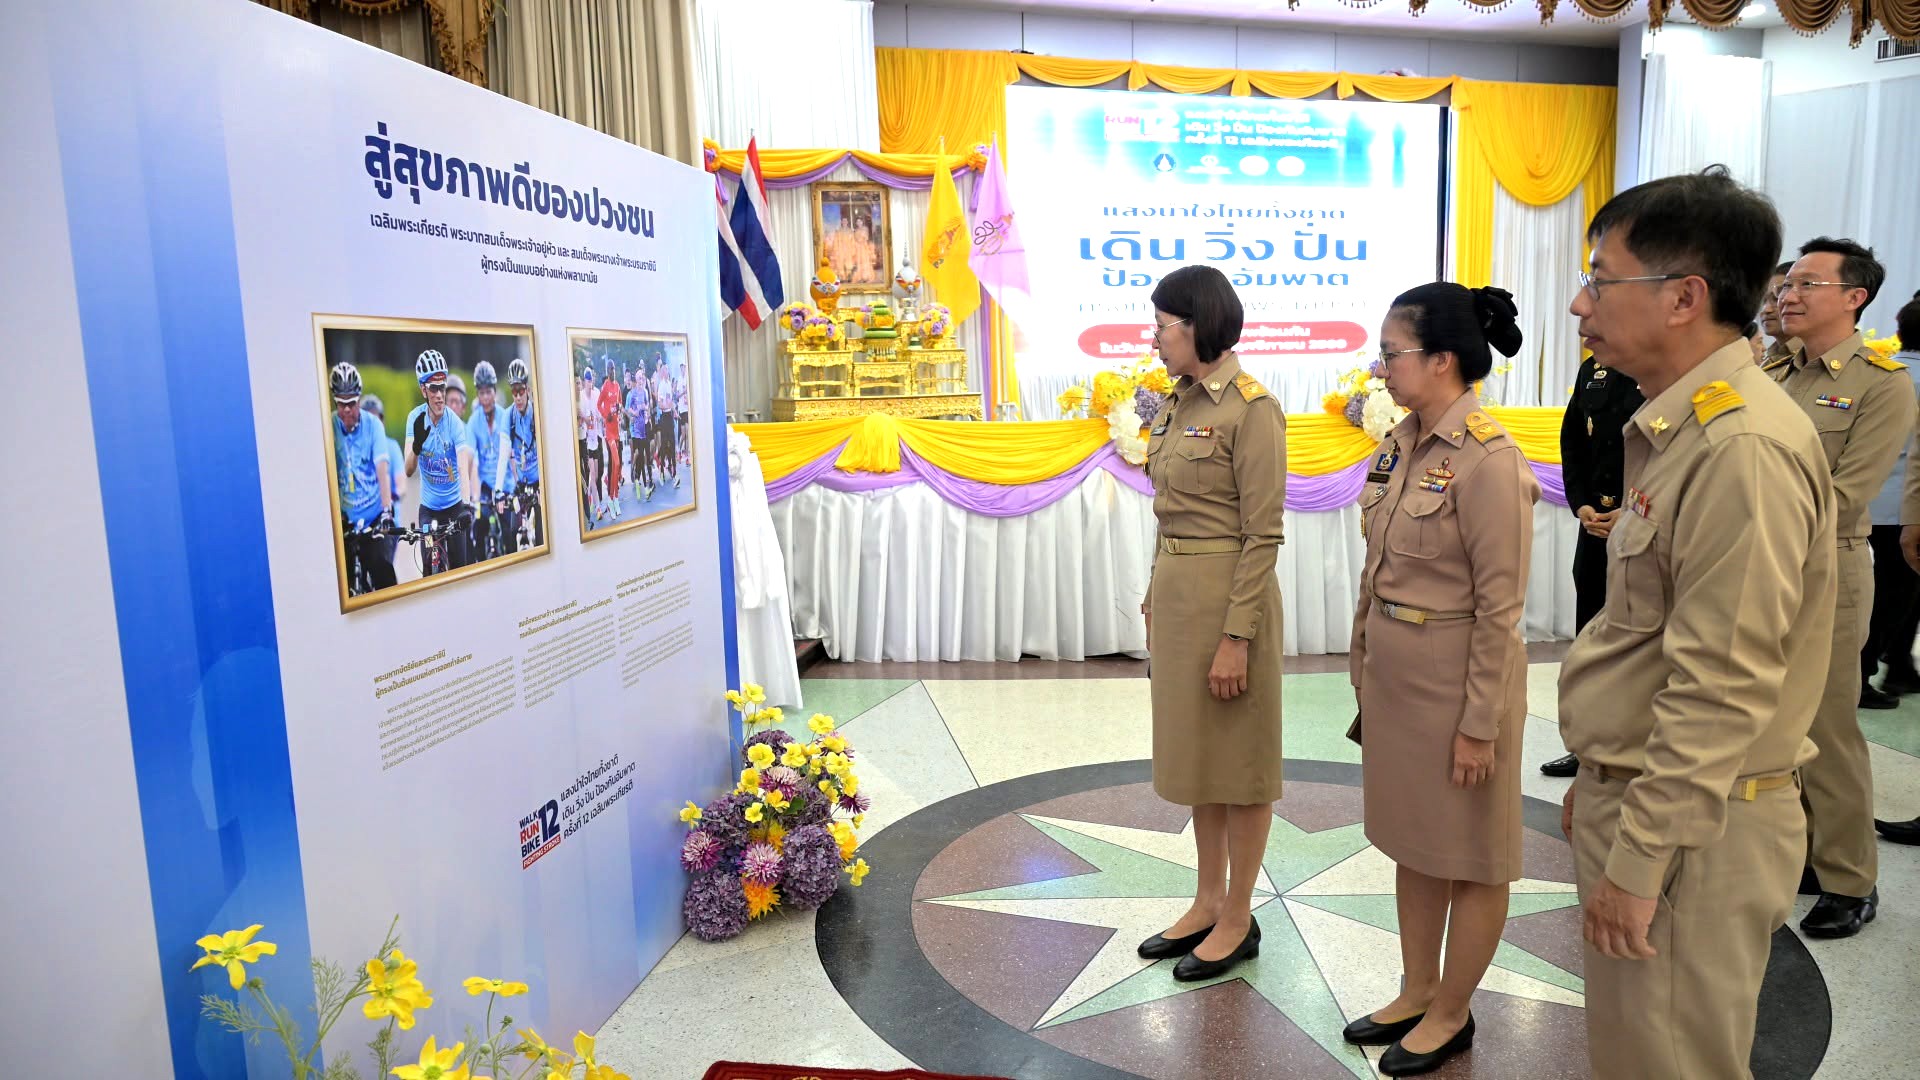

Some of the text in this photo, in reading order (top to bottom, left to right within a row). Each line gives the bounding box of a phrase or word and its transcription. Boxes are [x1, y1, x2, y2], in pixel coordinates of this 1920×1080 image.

[365, 121, 655, 238] สู่สุขภาพดีของปวงชน
[1103, 201, 1346, 219] แสงนำใจไทยทั้งชาต
[370, 212, 448, 239] เฉลิมพระเกียรติ
[450, 227, 557, 259] พระบาทสมเด็จพระเจ้าอยู่หัว
[558, 246, 570, 258] และ
[1080, 222, 1367, 261] เดิน วิ่ง ปั่น
[480, 254, 598, 284] ผู้ทรงเป็นแบบอย่างแห่งพลานามัย
[560, 753, 619, 802] แสงนำใจไทยทั้งชาติ
[519, 810, 538, 829] WALK
[538, 799, 560, 843] 12
[562, 805, 575, 821] เดิน
[576, 796, 585, 812] วิ่ง
[585, 788, 595, 804] ปั่น
[563, 779, 634, 839] ครั้งที่ 12 เฉลิมพระเกียรติ
[520, 821, 540, 844] RUN
[521, 835, 540, 858] BIKE
